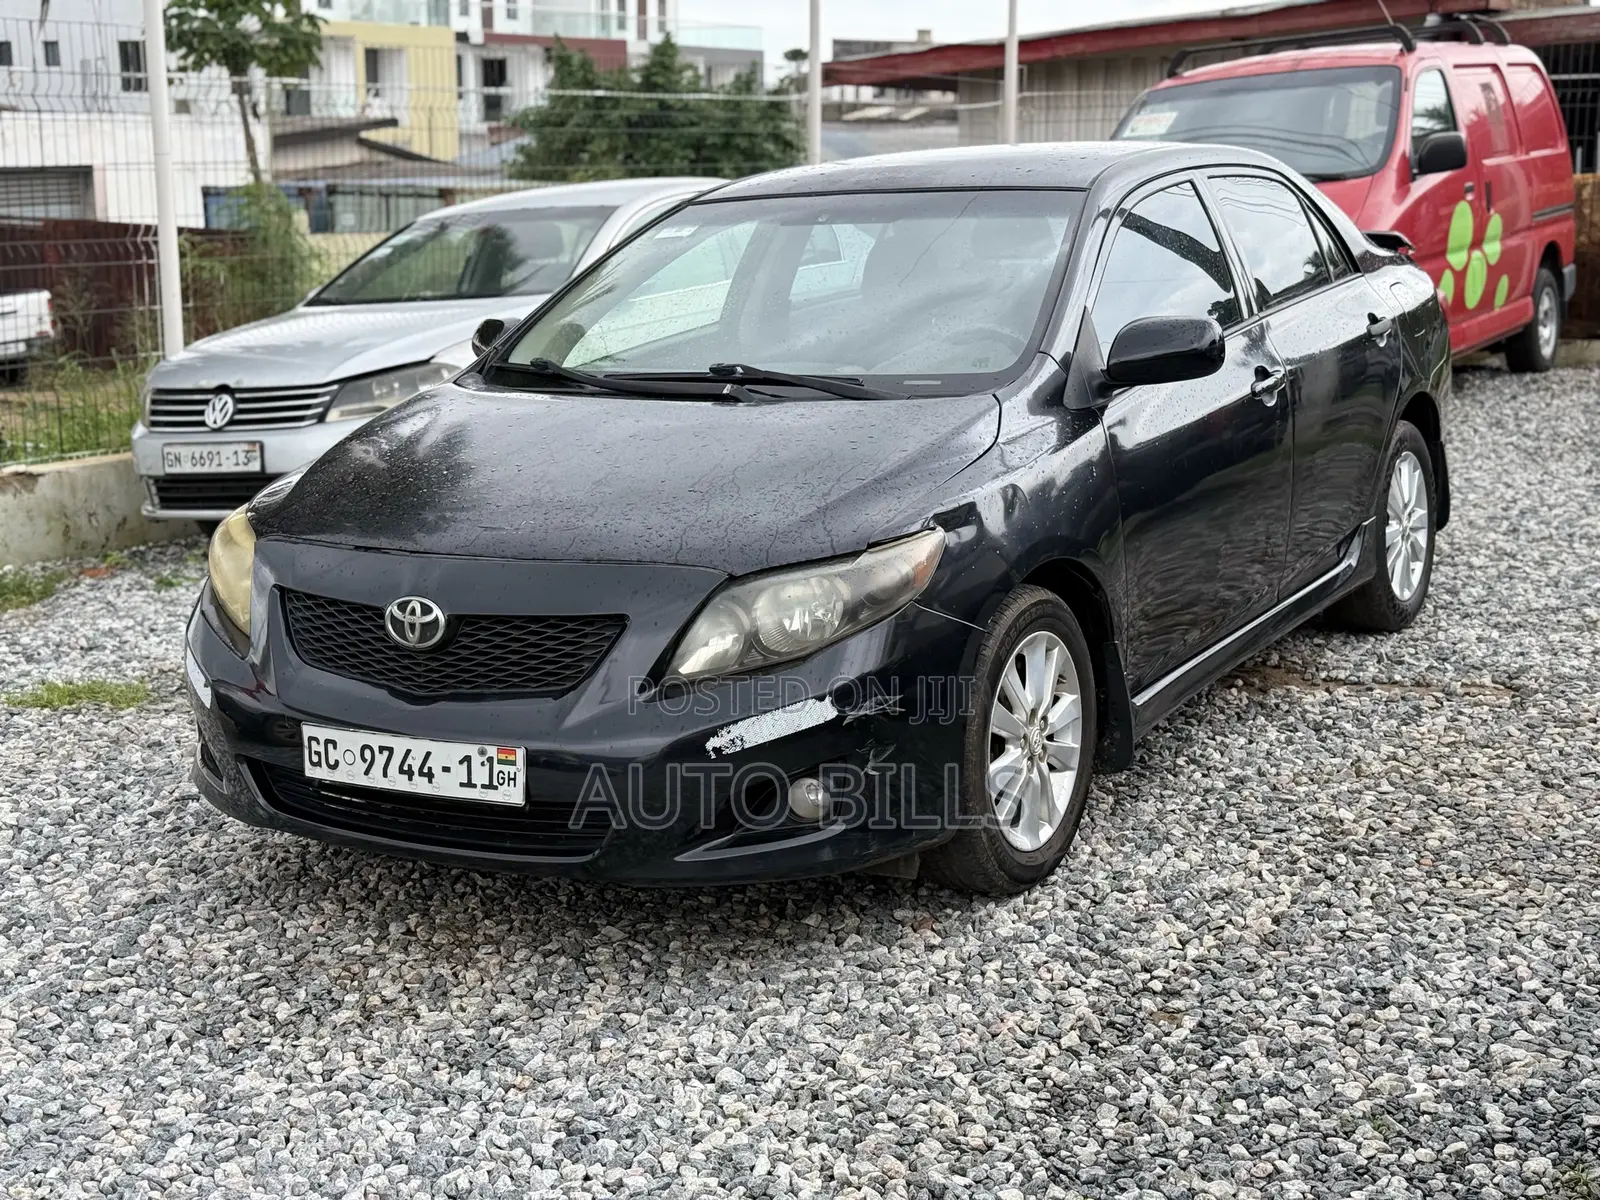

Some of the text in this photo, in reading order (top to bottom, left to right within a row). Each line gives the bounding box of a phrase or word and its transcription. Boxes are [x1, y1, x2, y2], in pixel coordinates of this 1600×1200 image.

[165, 452, 182, 468] GN
[307, 736, 499, 790] GC 9744-11
[497, 770, 517, 788] GH
